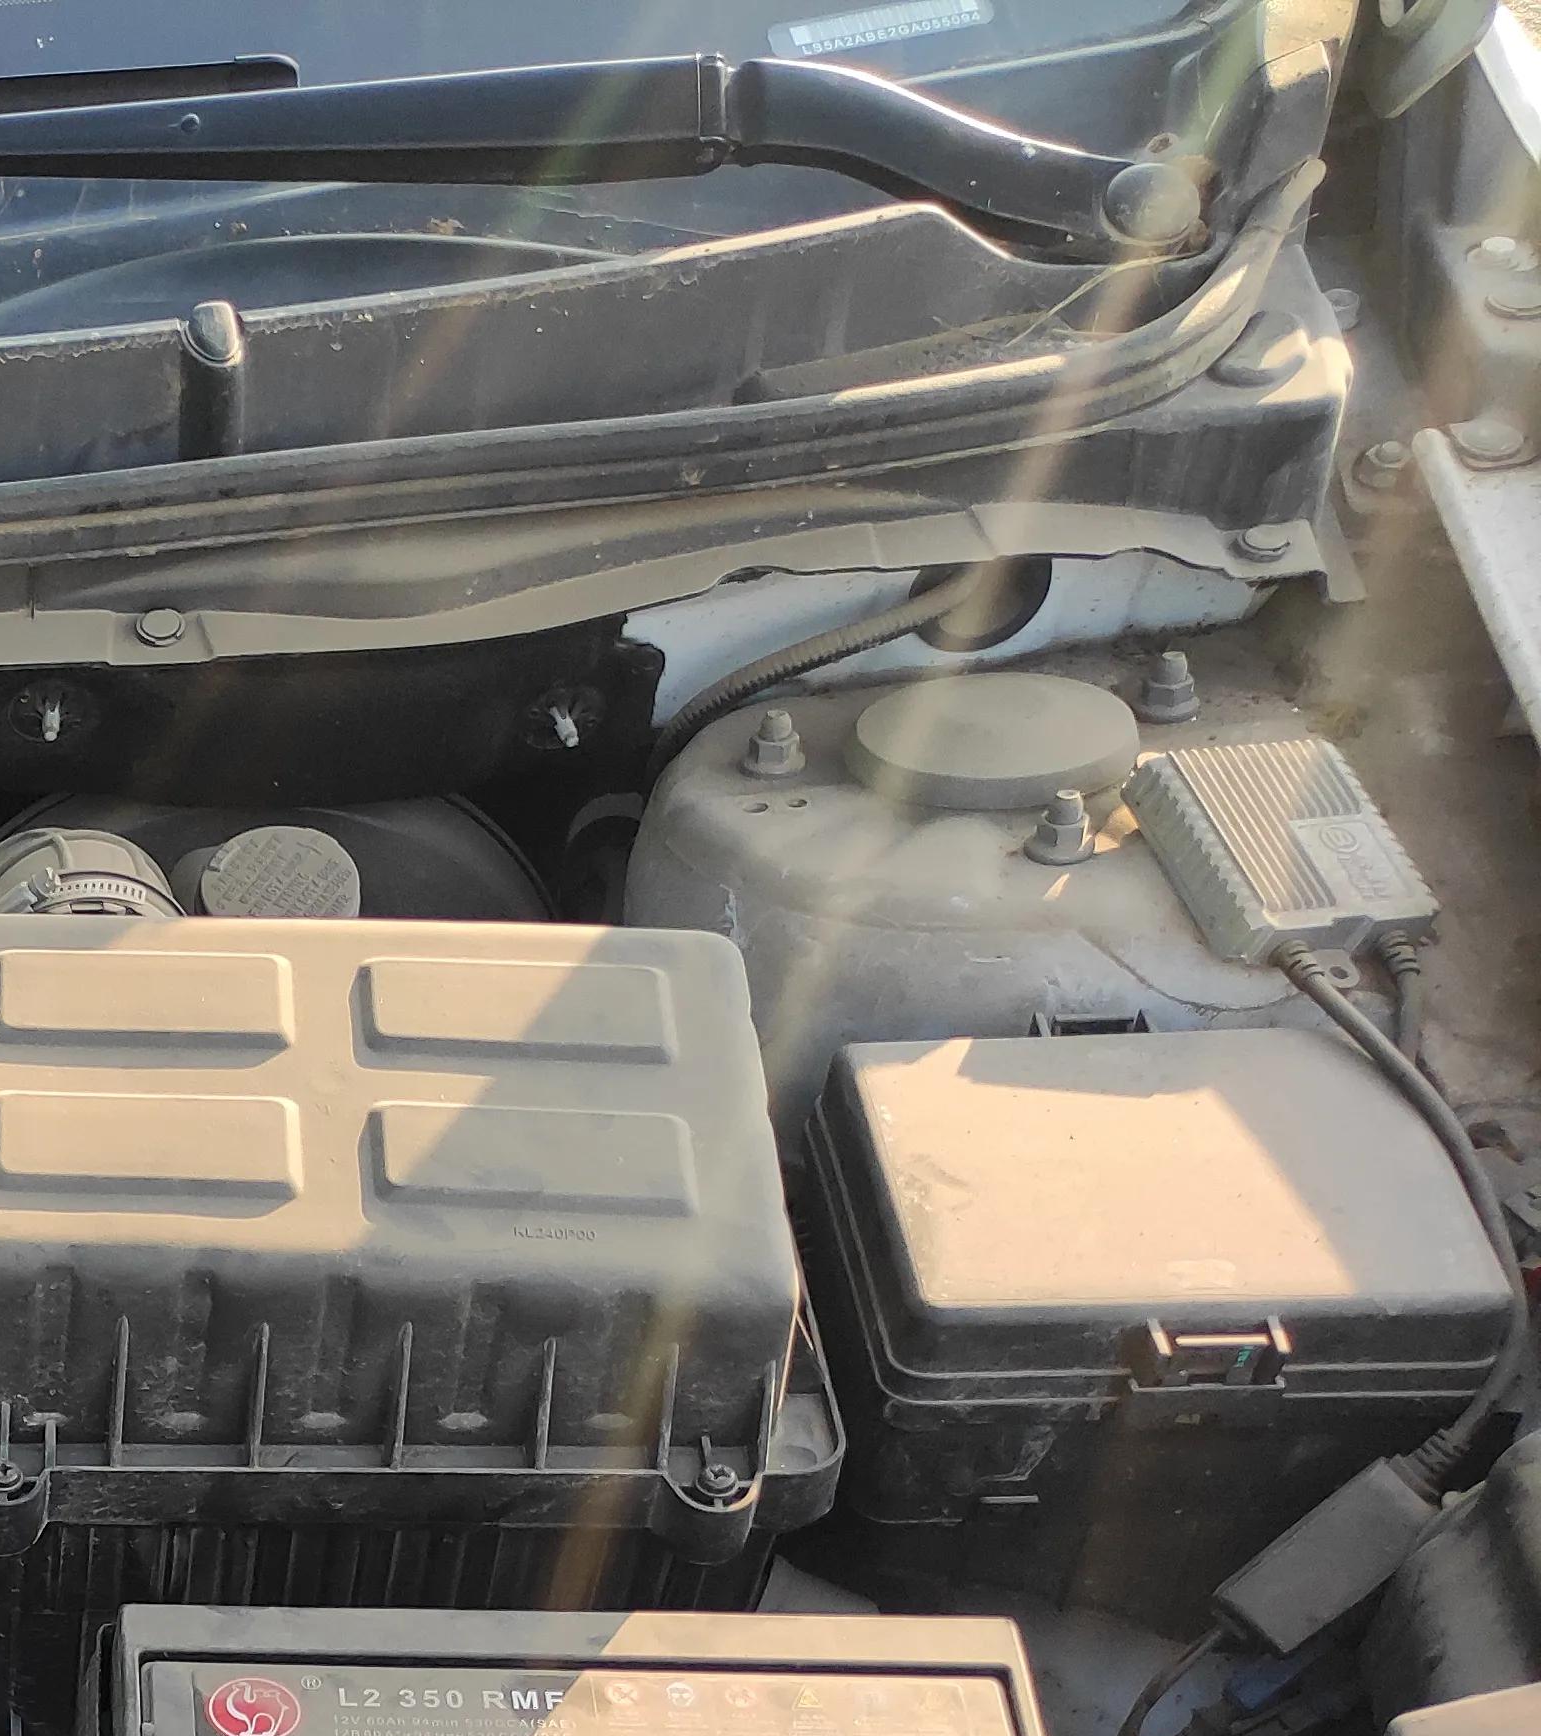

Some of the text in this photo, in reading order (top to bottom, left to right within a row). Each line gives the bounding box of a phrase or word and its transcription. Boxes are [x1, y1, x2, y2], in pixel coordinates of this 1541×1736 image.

[338, 1687, 565, 1711] L2 350 RMF
